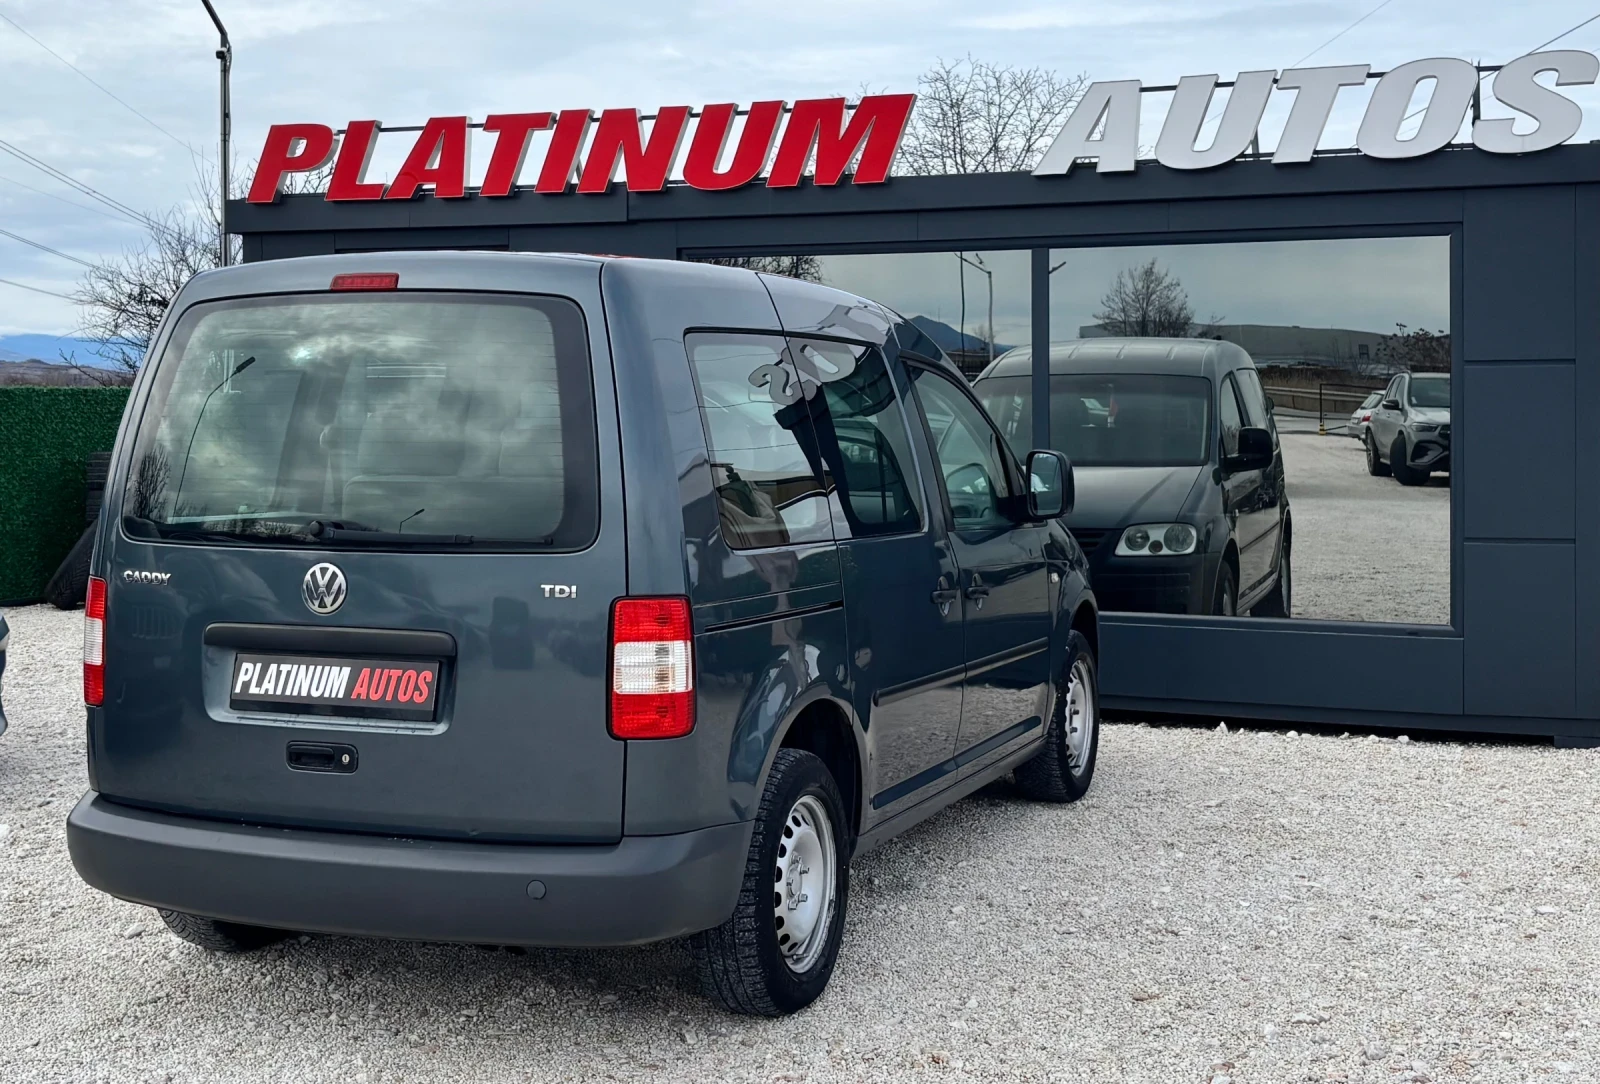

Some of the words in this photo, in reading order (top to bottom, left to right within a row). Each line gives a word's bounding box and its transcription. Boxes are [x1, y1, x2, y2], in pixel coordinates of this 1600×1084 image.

[246, 93, 918, 204] PLATINUM
[1030, 49, 1600, 177] AUTOS
[122, 569, 172, 586] CADDY
[540, 583, 578, 599] TDI
[234, 661, 352, 699] PLATINUM
[350, 667, 433, 704] AUTOS
